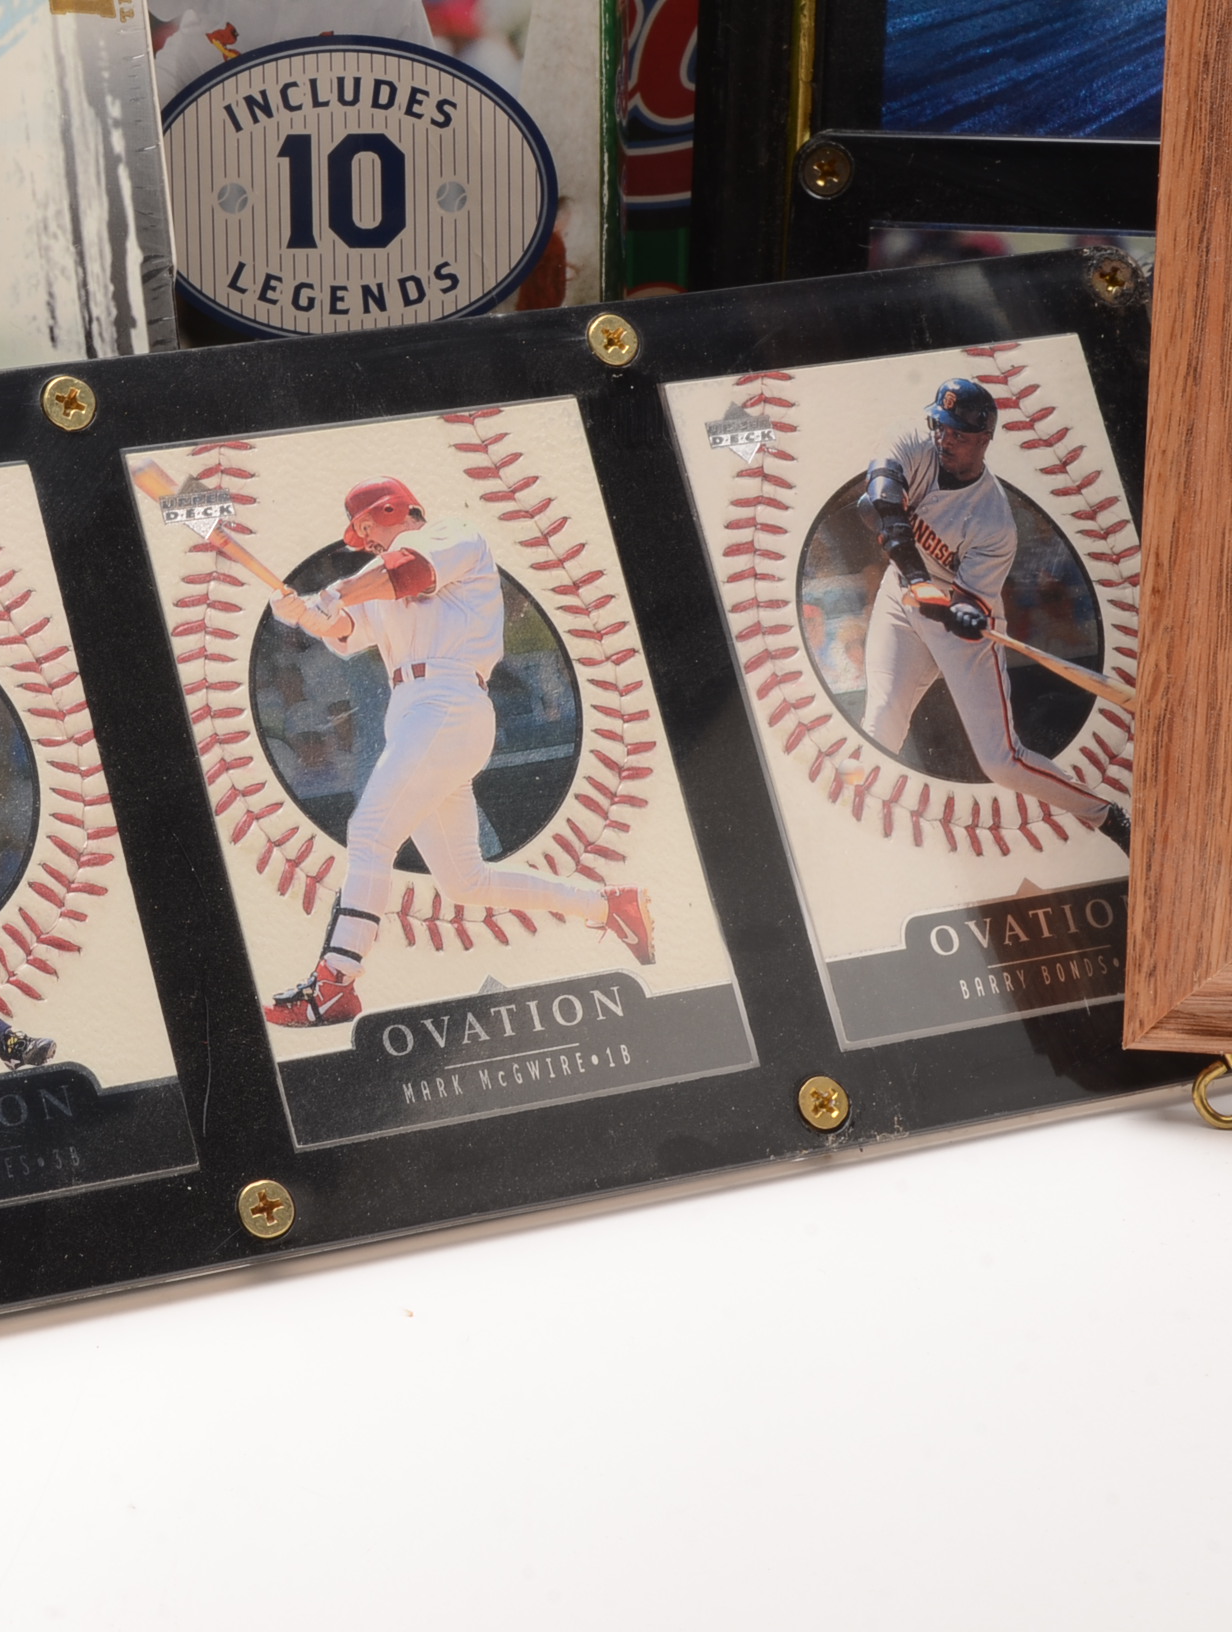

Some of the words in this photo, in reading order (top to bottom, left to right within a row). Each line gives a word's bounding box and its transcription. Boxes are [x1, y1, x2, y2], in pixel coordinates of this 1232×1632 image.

[222, 75, 458, 133] INCLUDES
[276, 133, 406, 249] 10
[227, 261, 460, 315] LEGENDS
[929, 895, 1129, 957] OVATIO
[959, 969, 1027, 1000] BARRY
[382, 986, 625, 1057] OVATION
[402, 1074, 464, 1104] MARK
